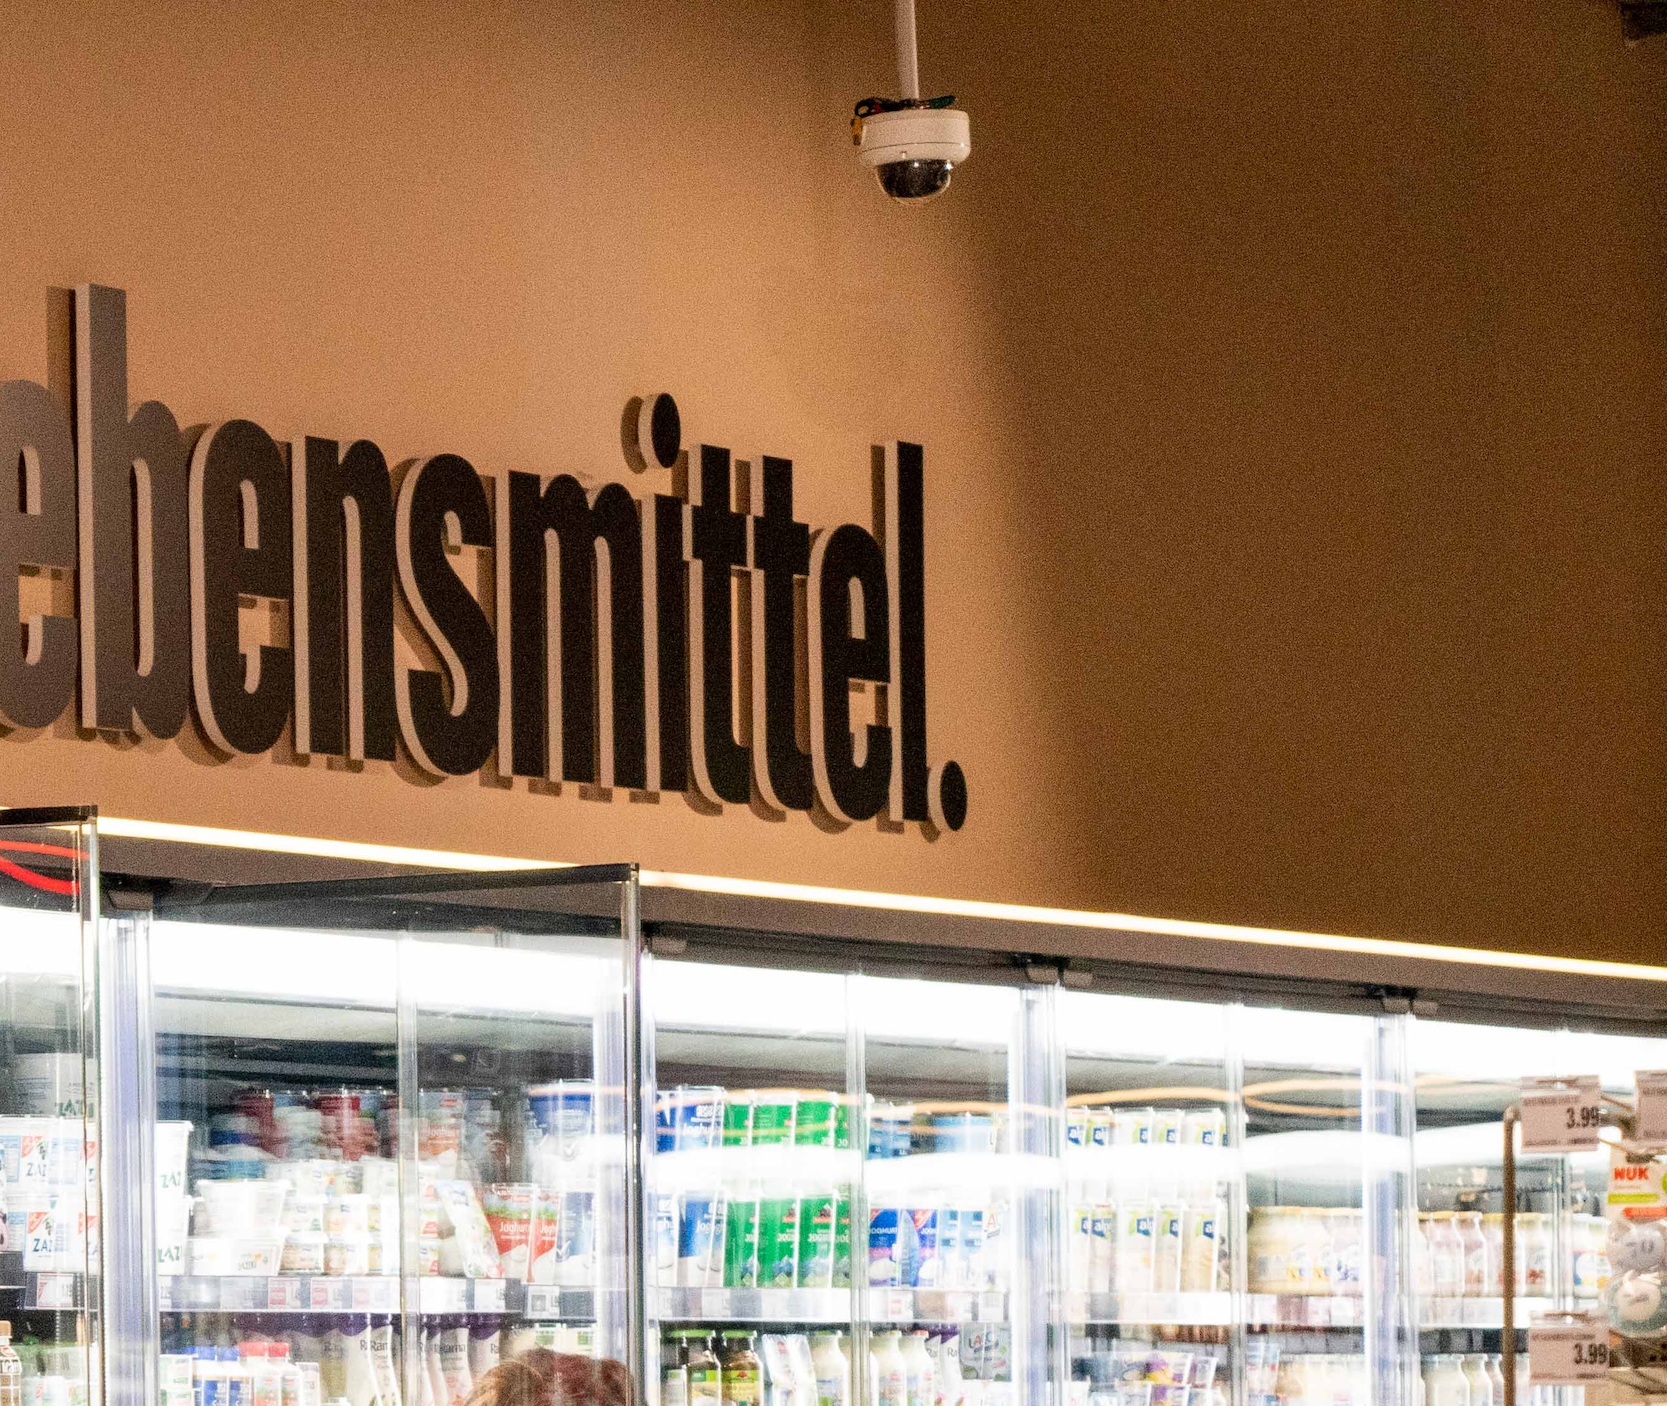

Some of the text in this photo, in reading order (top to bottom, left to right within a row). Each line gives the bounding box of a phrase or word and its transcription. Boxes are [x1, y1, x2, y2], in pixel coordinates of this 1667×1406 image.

[1566, 1107, 1600, 1130] 3.99
[1614, 1167, 1650, 1182] NUK
[1573, 1343, 1609, 1366] 3.99
